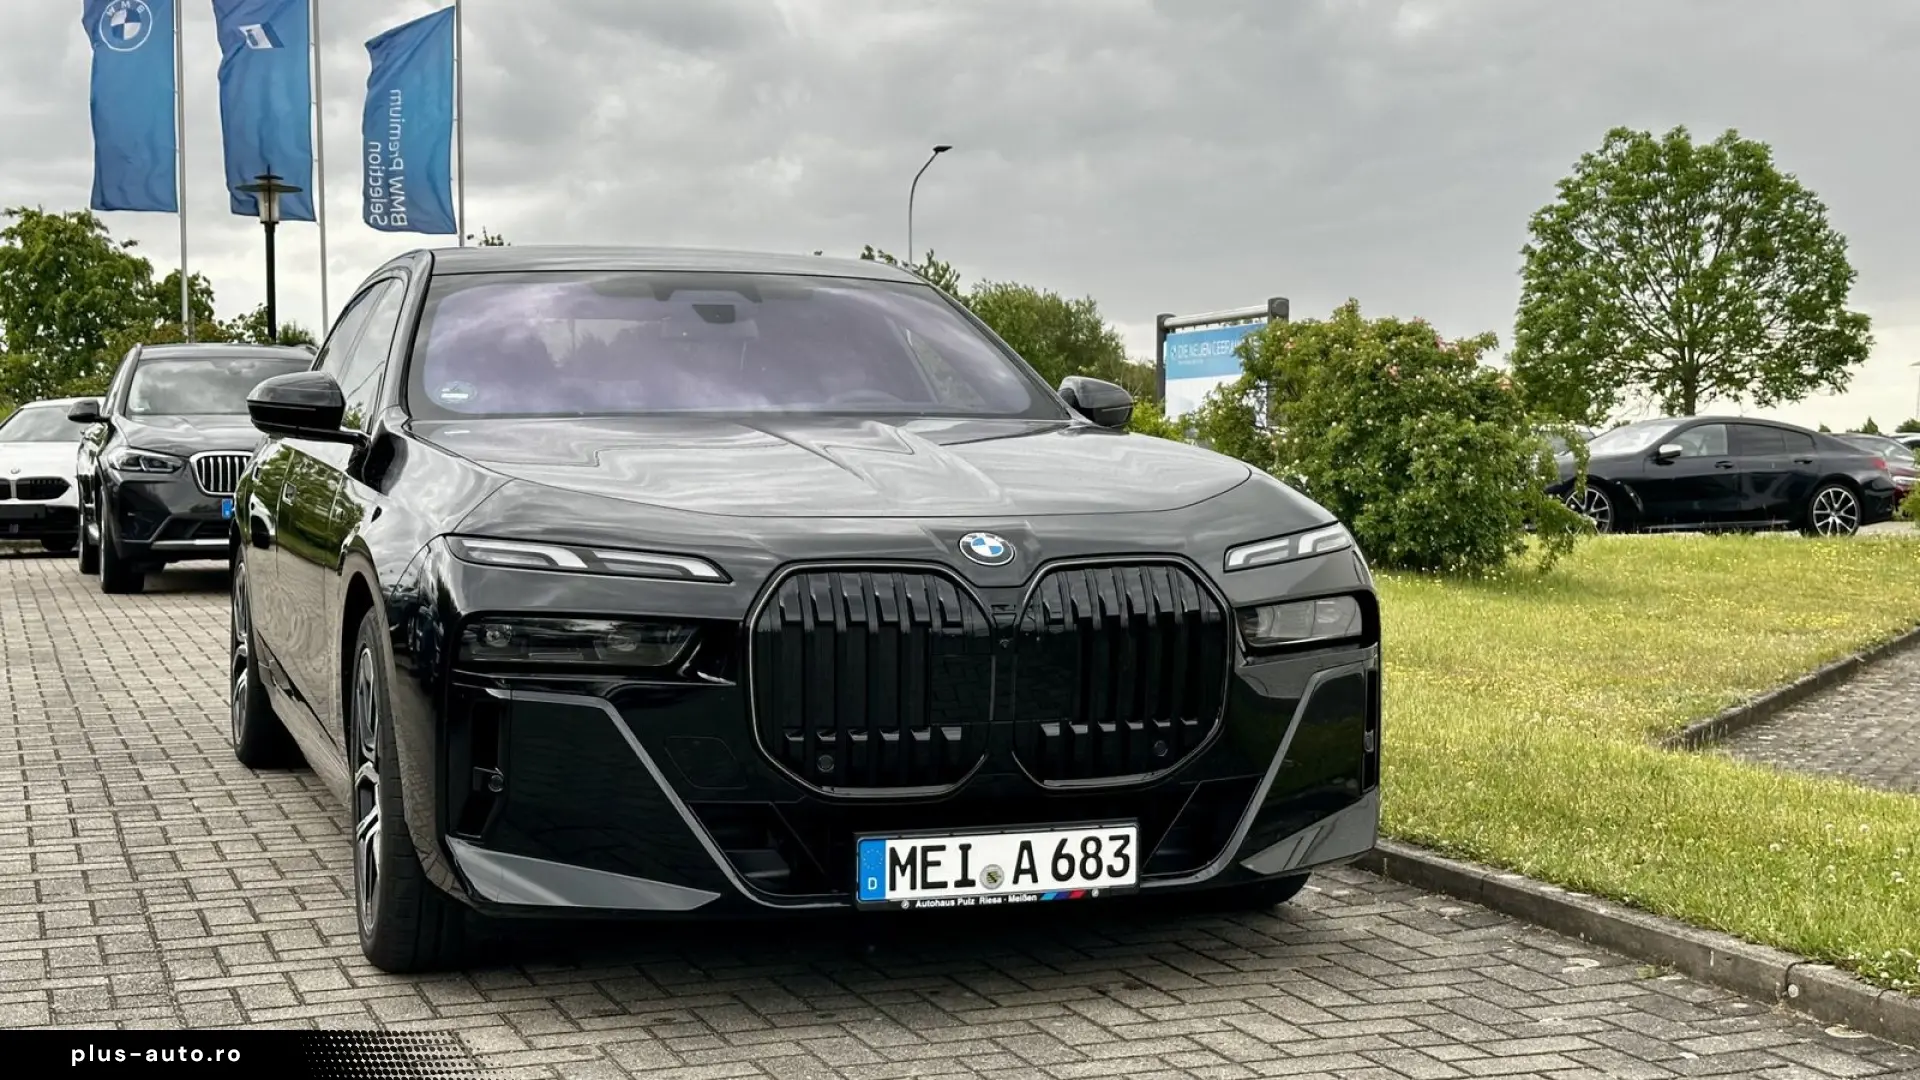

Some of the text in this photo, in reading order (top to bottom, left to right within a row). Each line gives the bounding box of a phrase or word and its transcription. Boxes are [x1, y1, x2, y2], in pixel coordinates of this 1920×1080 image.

[889, 834, 1131, 891] MEI A 683
[868, 877, 877, 890] D
[915, 898, 955, 908] Autohaus
[957, 897, 975, 906] Pulz
[979, 896, 1002, 905] Riesa
[1008, 894, 1038, 904] Meißen
